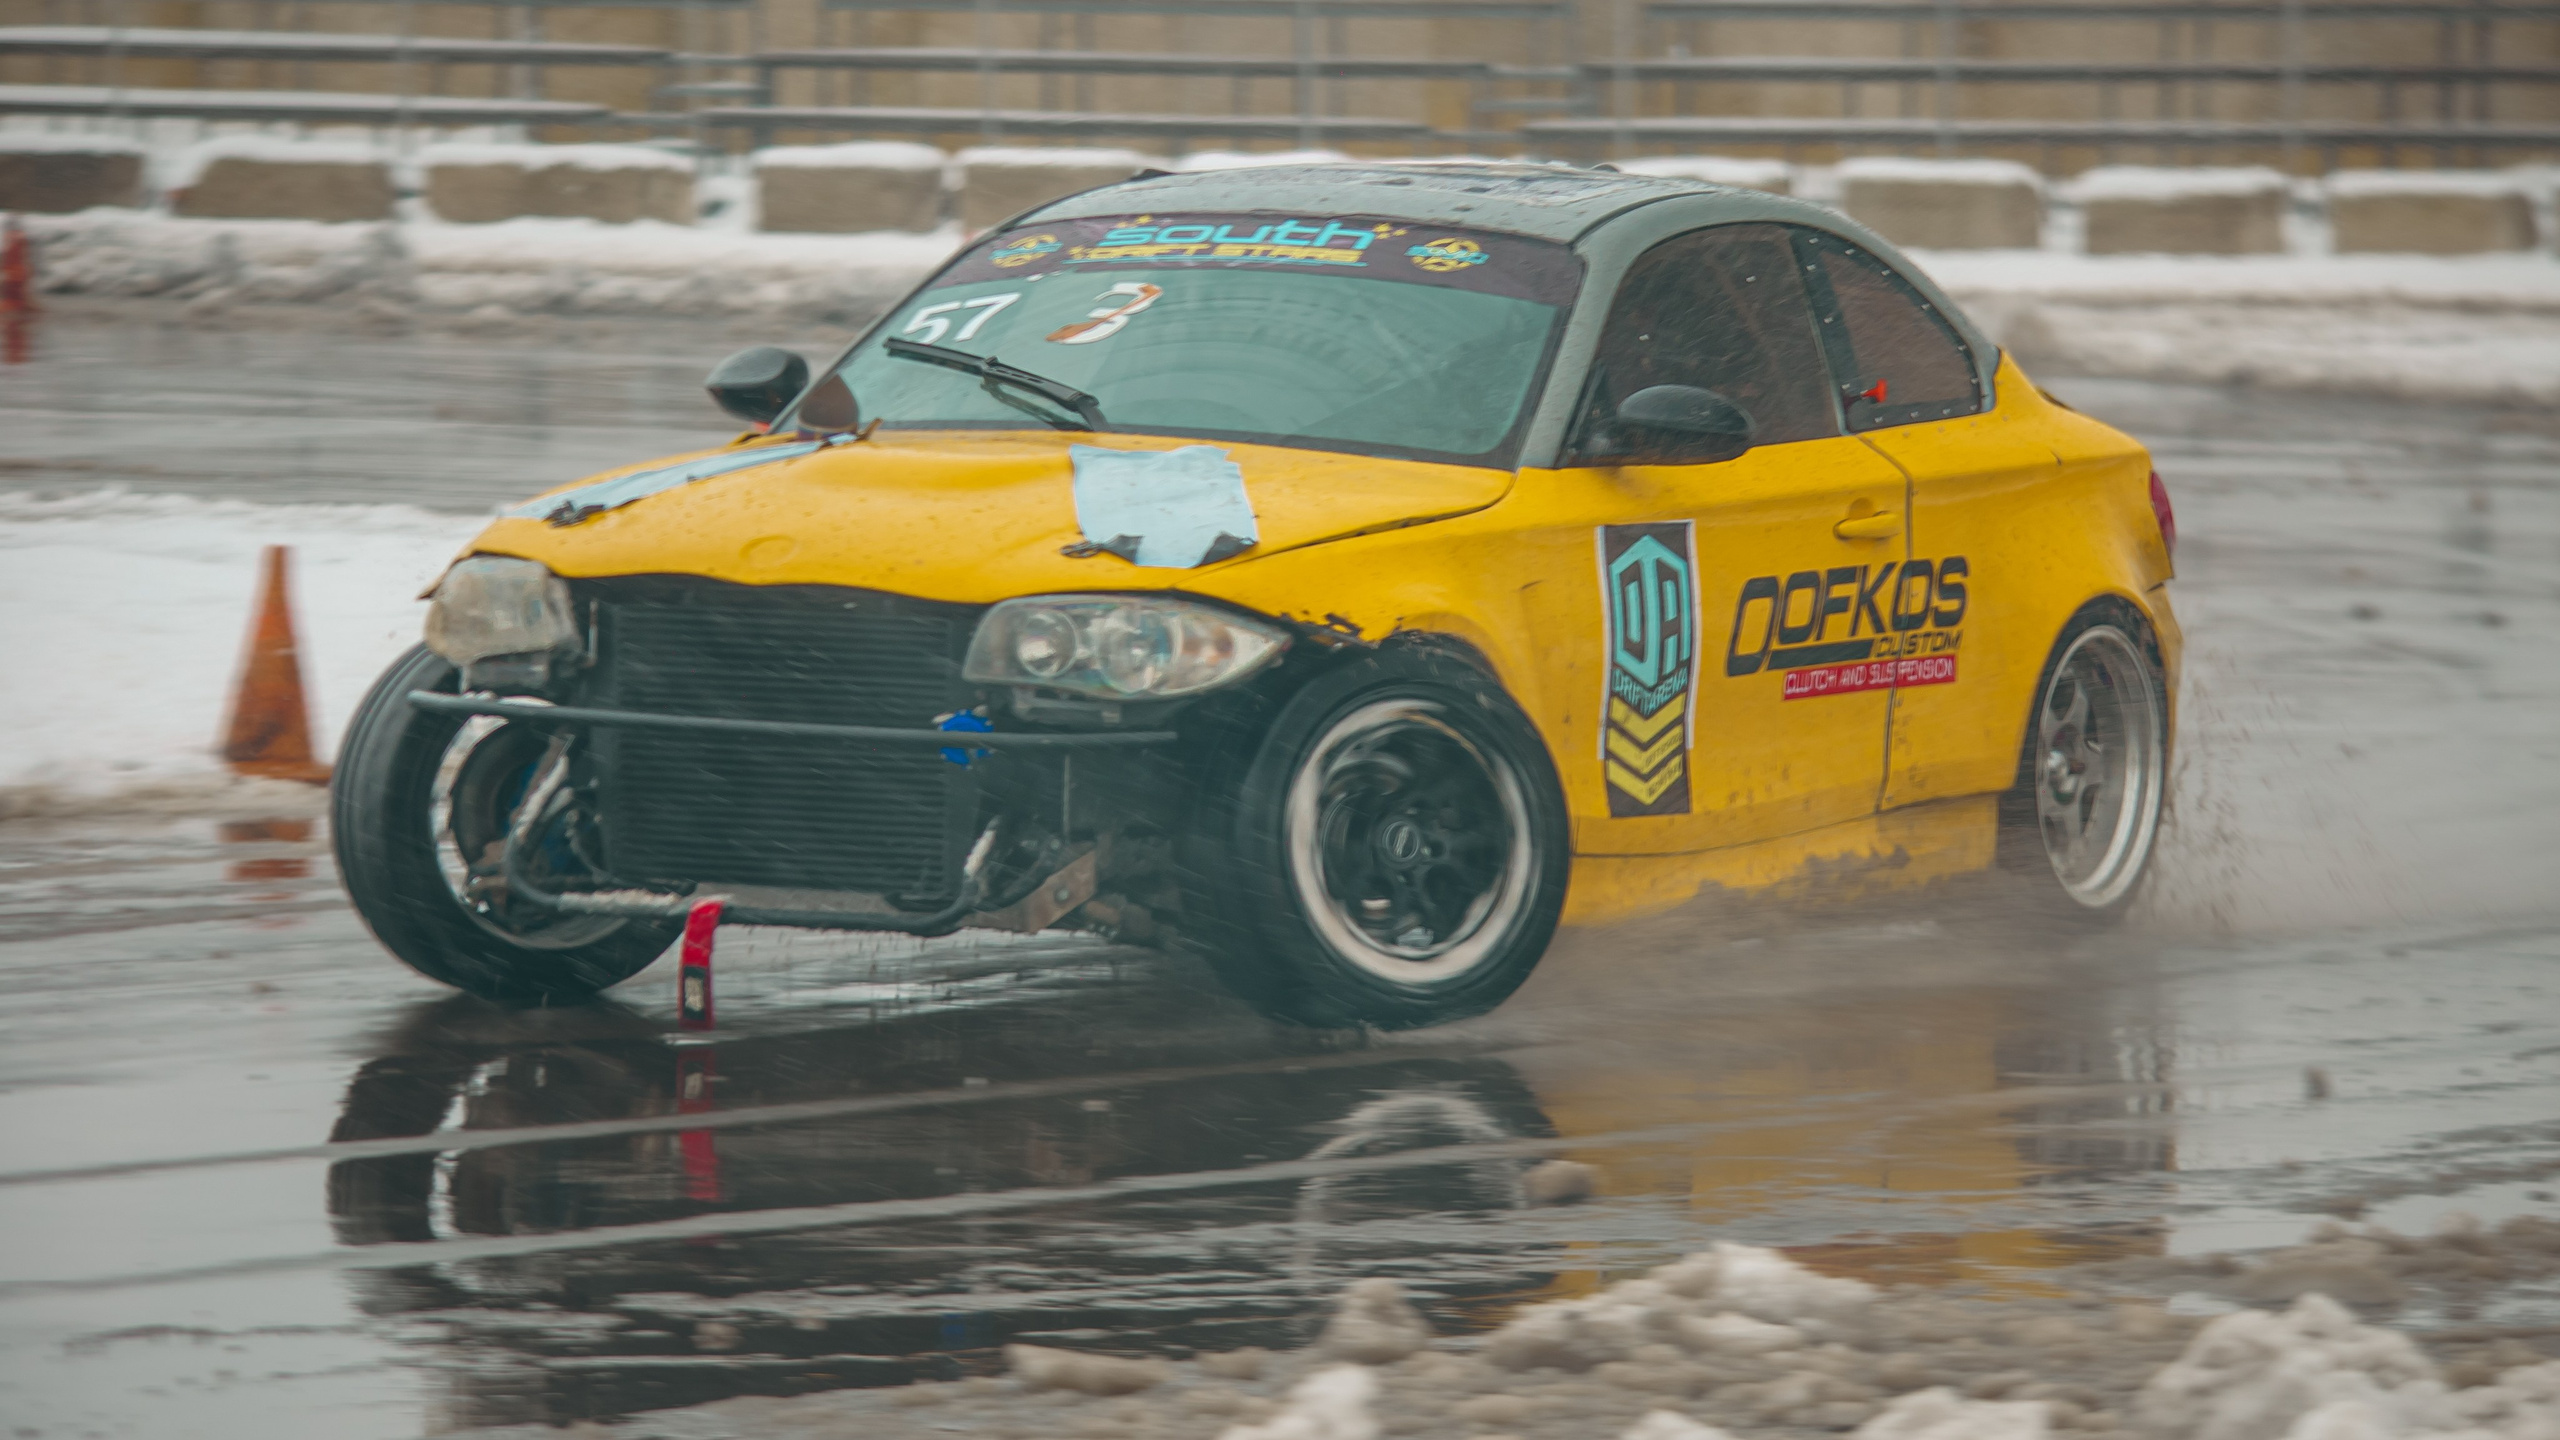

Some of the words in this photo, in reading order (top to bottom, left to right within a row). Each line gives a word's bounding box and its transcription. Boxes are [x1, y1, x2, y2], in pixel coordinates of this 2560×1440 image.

[903, 291, 1021, 346] 57
[1045, 282, 1163, 344] 3
[1875, 630, 1962, 658] CUSTOM
[1784, 669, 1838, 694] CLUTCH
[1840, 665, 1867, 686] AND
